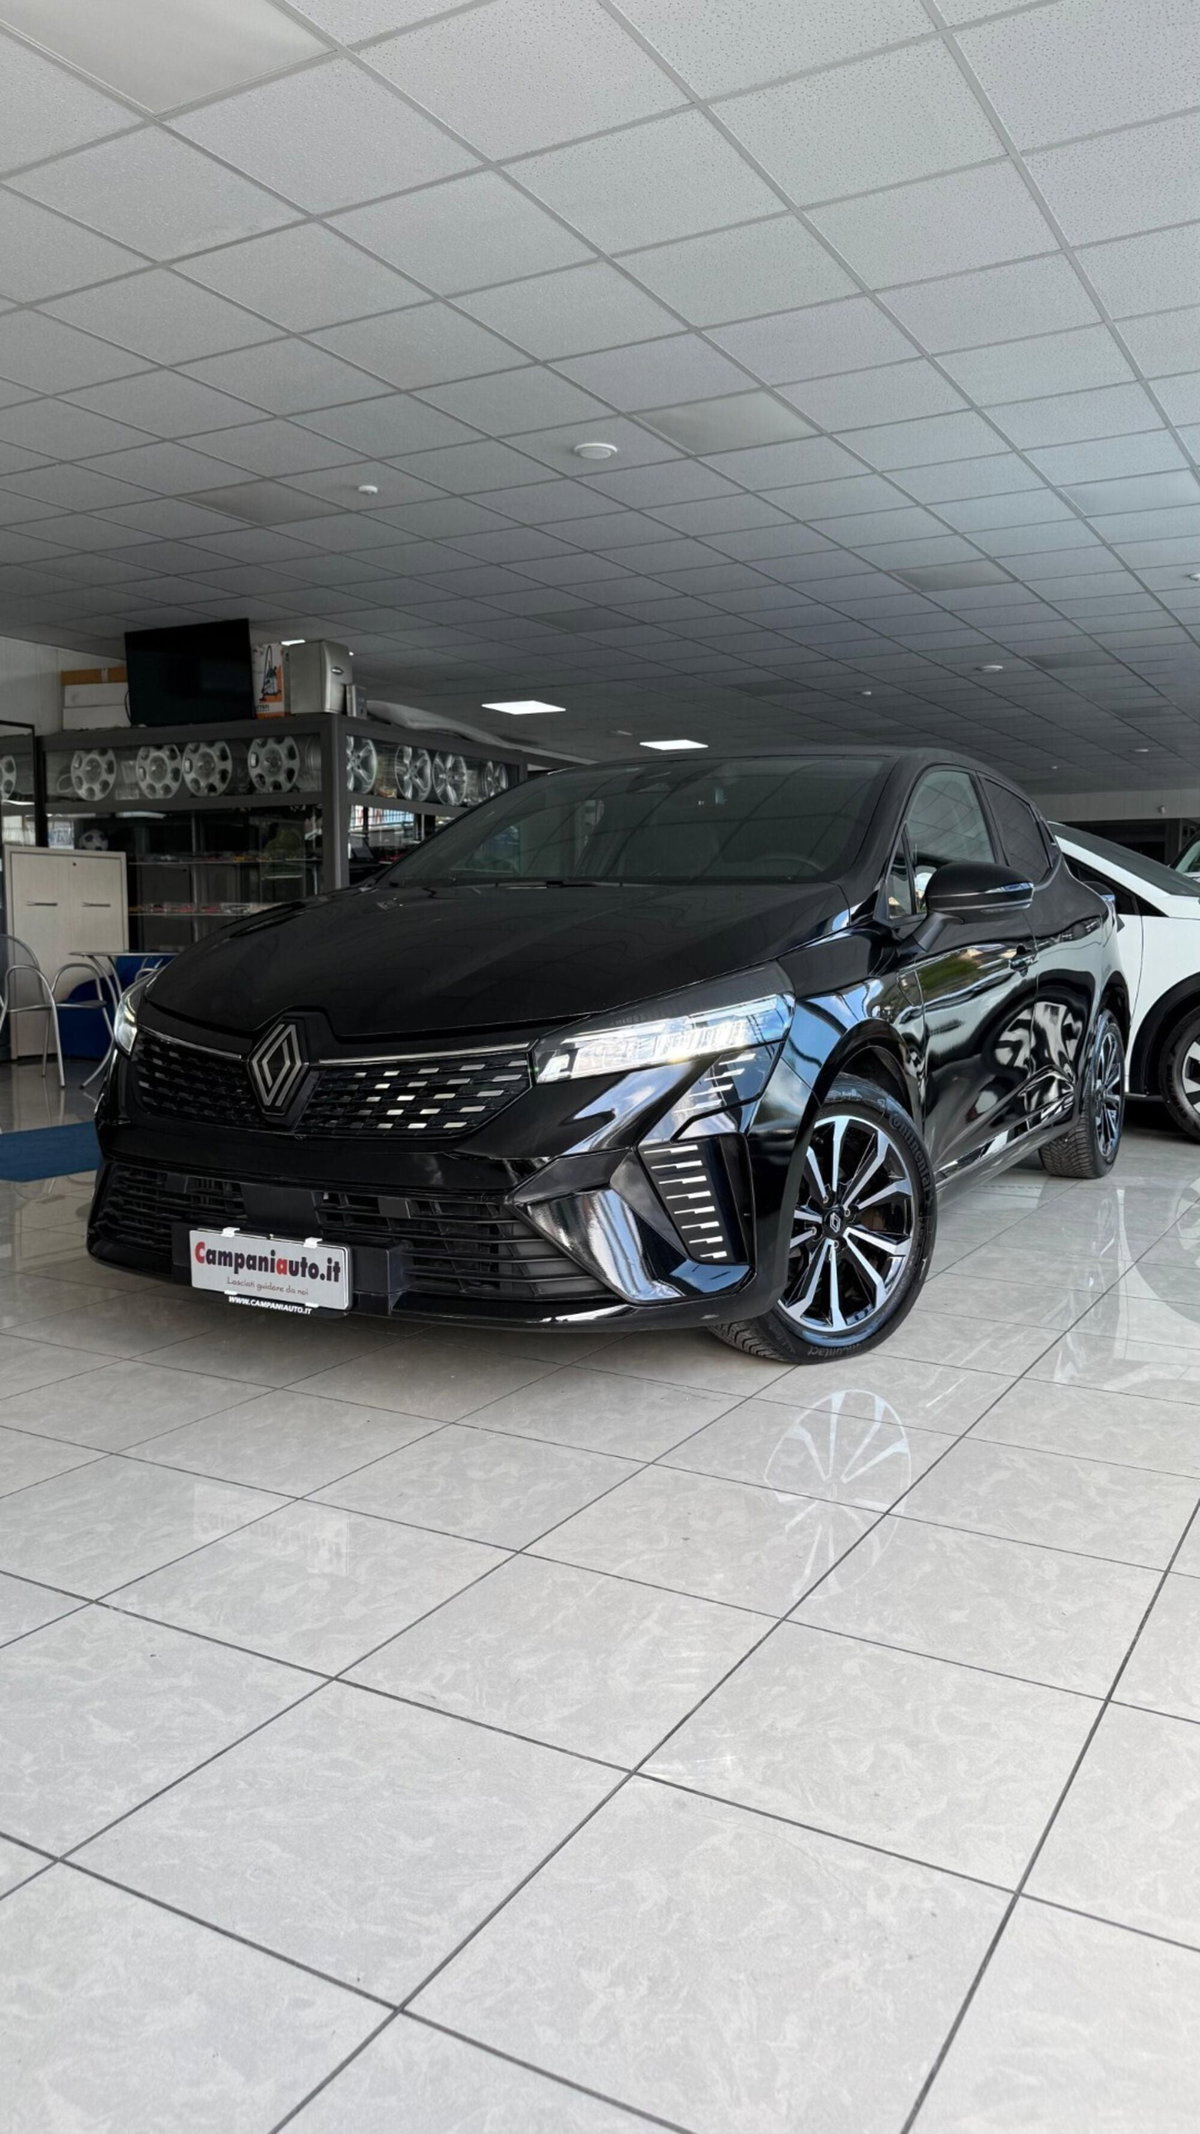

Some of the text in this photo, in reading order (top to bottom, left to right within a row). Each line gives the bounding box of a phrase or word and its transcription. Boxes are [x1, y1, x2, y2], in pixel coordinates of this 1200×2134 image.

[195, 1242, 341, 1282] Campaniauto.it
[286, 1285, 296, 1295] da
[297, 1288, 309, 1296] noi
[228, 1296, 312, 1315] WWW.CAMPANIAUTO.IT
